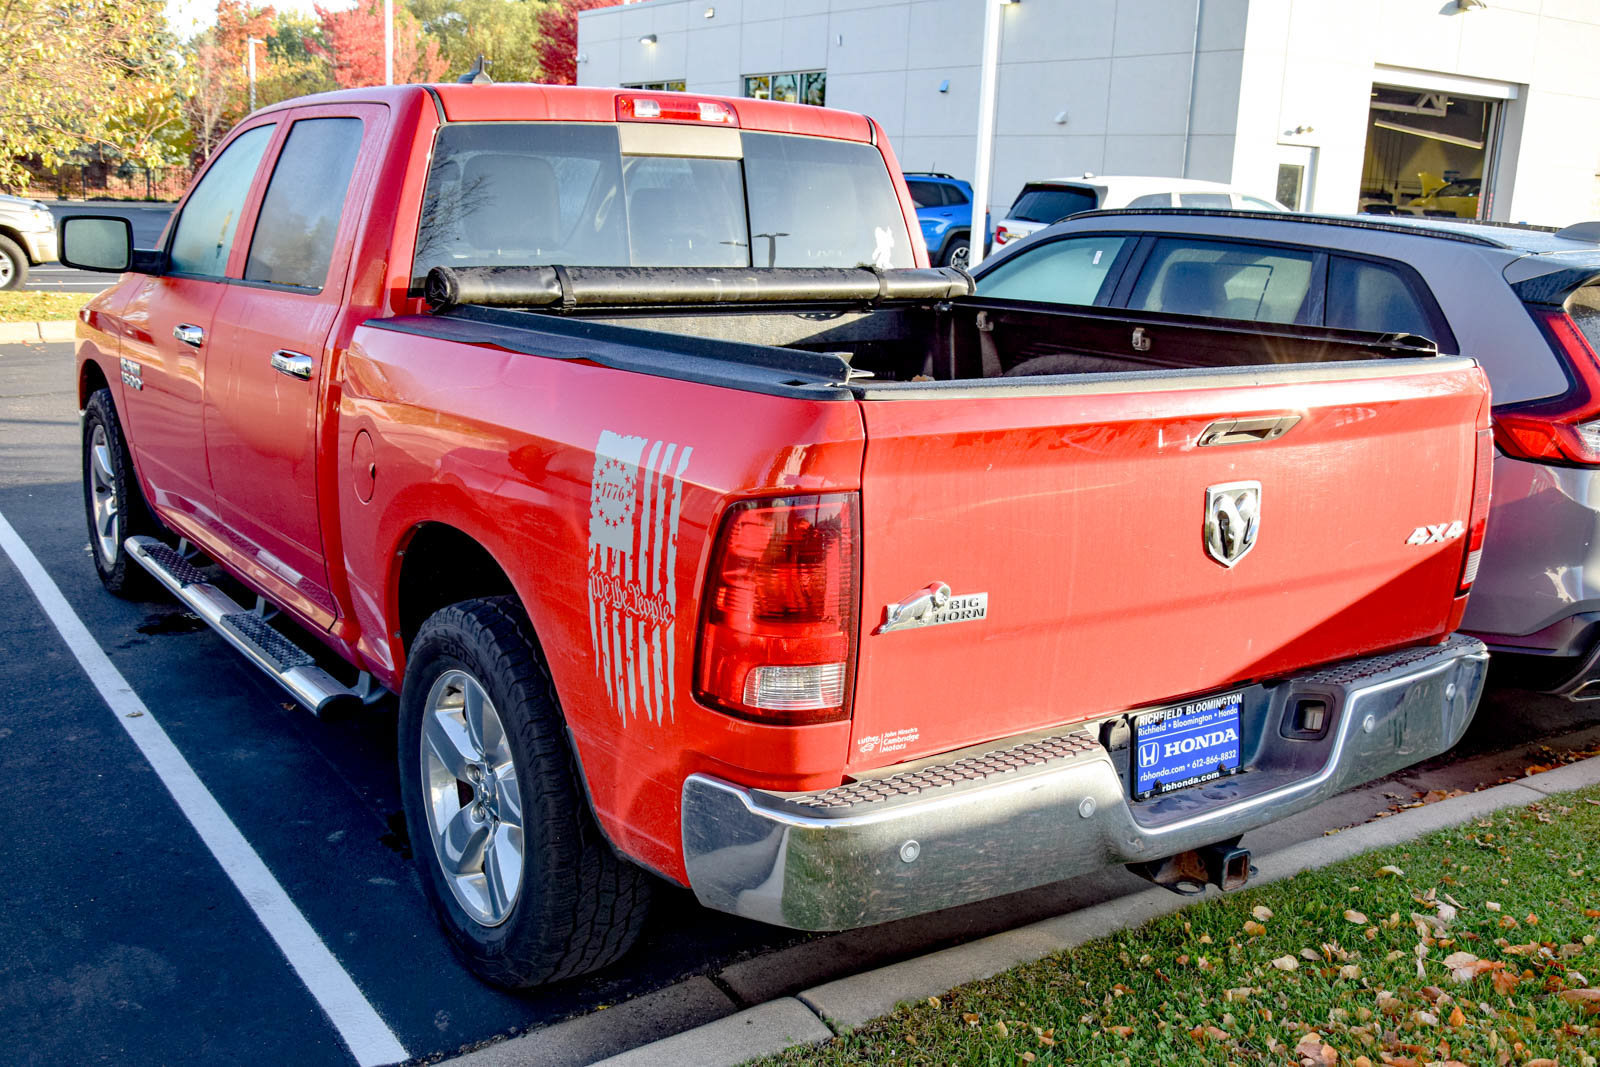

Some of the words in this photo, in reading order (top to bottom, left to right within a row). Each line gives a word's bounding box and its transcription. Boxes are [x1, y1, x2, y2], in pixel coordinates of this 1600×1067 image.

[121, 371, 144, 391] 1500
[602, 481, 625, 502] 1776
[1404, 520, 1466, 546] 4X4
[590, 569, 612, 606] We
[626, 582, 675, 629] People
[949, 598, 979, 610] BIG
[935, 608, 984, 622] HORN
[1139, 708, 1183, 727] RICHFIELD
[1186, 694, 1242, 715] BLOOMINGTON
[1138, 722, 1167, 737] Richfield
[1172, 713, 1213, 729] Bloomington
[1218, 707, 1238, 718] Honda
[883, 733, 920, 746] Cambridge
[884, 731, 897, 739] John
[1164, 728, 1238, 757] HONDA
[881, 743, 907, 753] Motors
[1140, 766, 1185, 782] rbhonda.com
[1192, 750, 1236, 768] 612-866-8832
[1162, 772, 1220, 792] rbhonda.com
